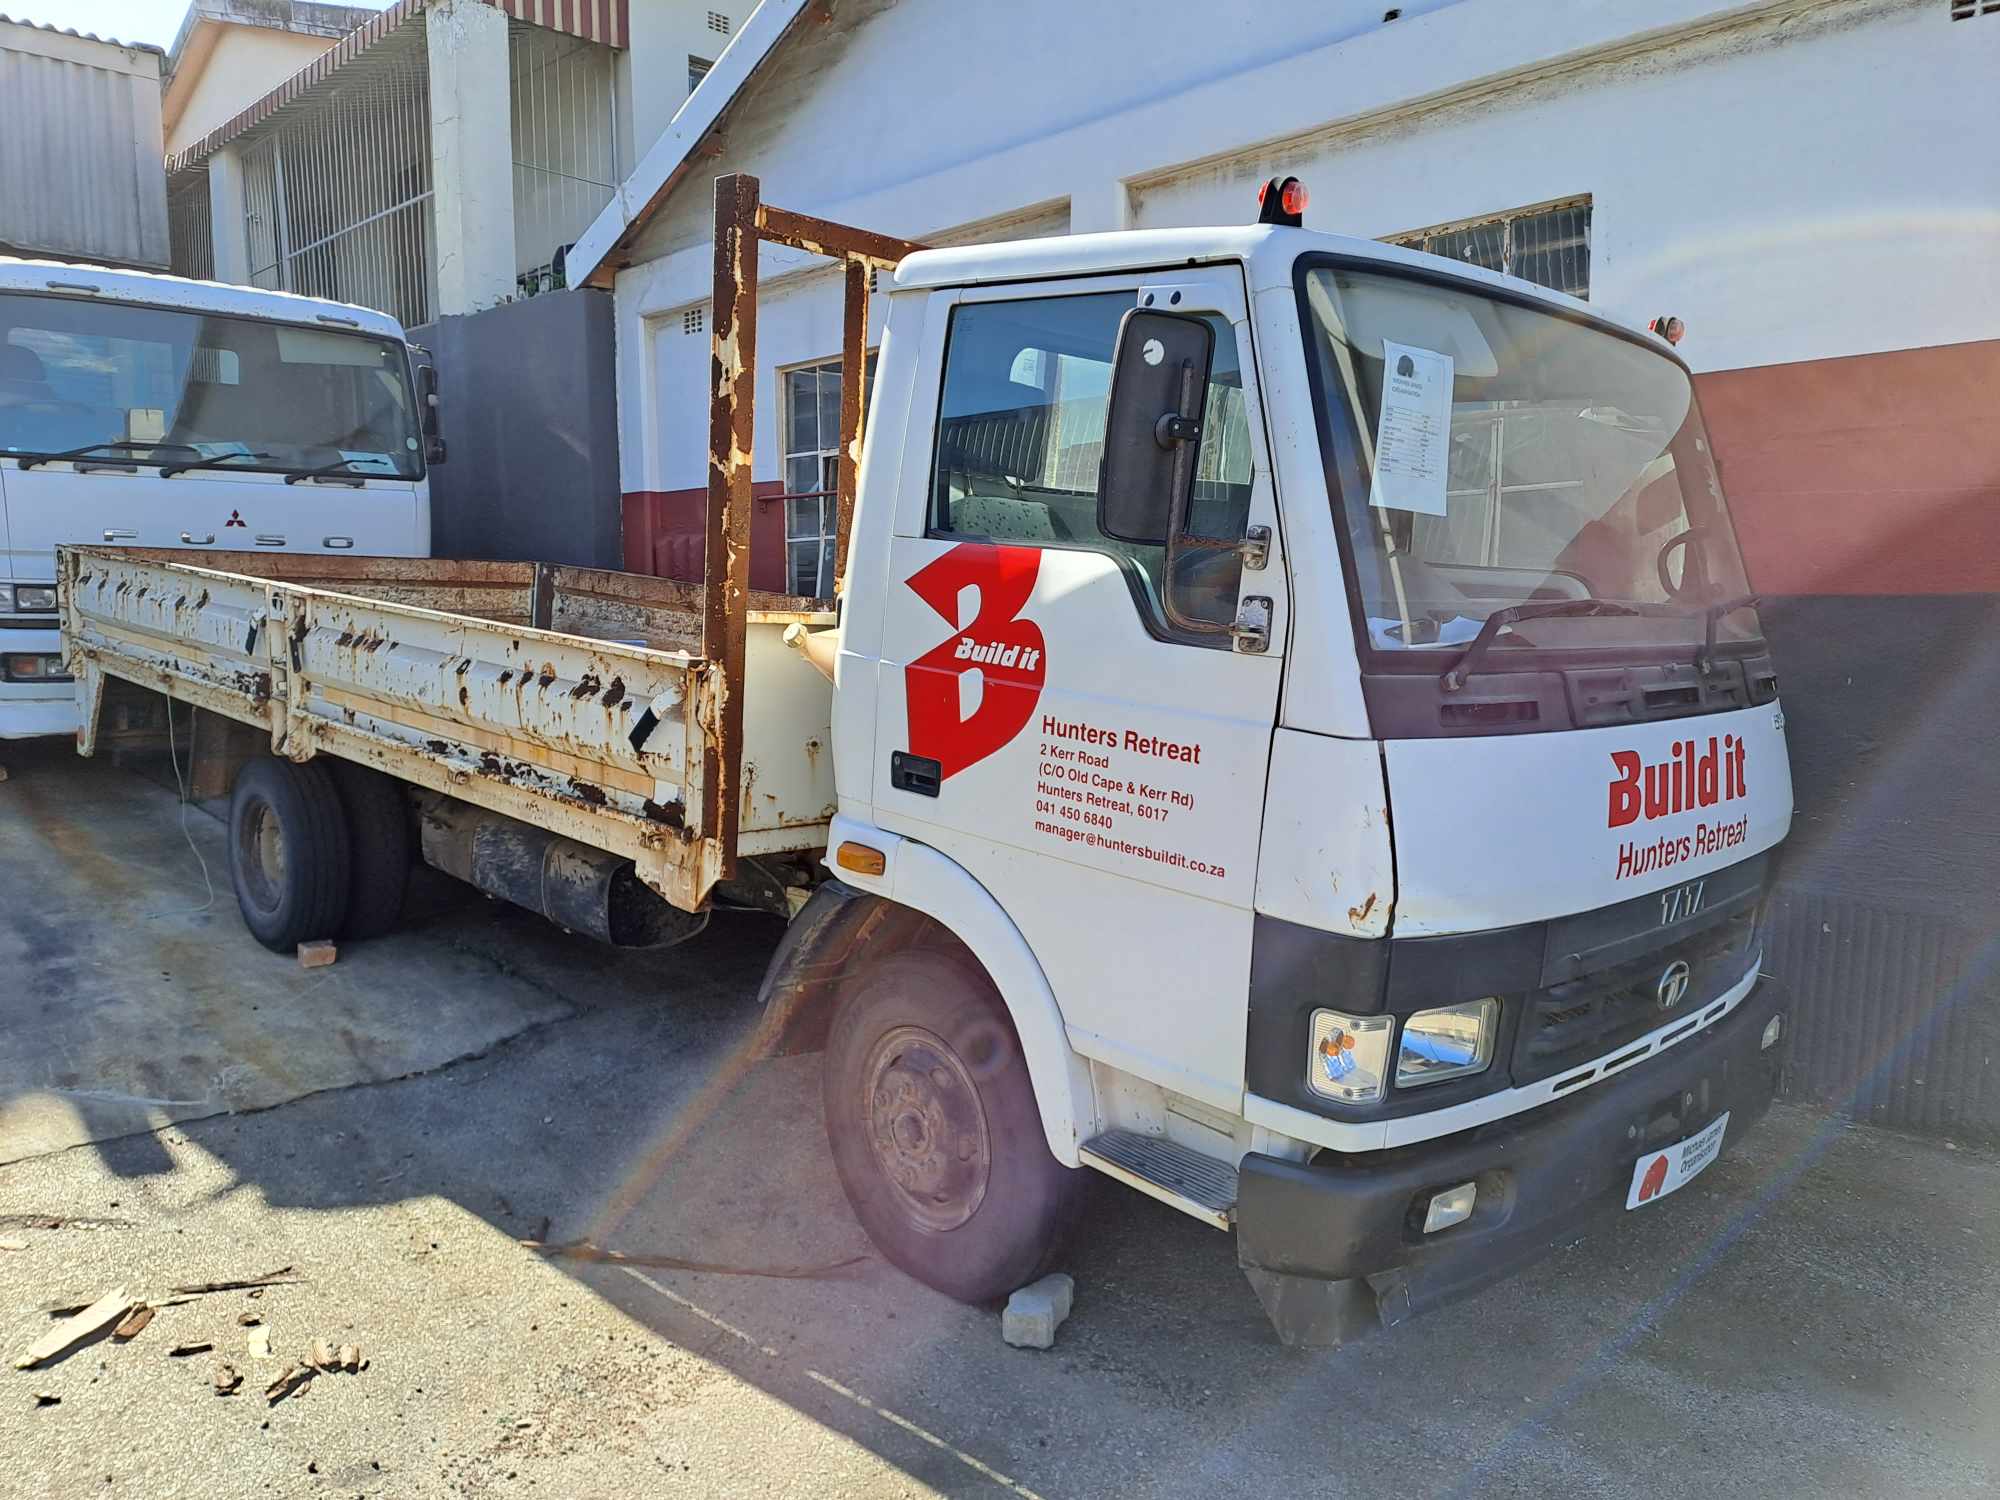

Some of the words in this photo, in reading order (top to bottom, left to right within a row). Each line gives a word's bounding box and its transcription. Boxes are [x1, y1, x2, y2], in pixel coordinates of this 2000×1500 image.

[103, 528, 354, 549] FUSO
[955, 637, 1018, 669] Build
[1018, 645, 1040, 671] it
[1040, 744, 1046, 755] 2
[1050, 745, 1075, 760] Kerr
[1078, 751, 1109, 768] Road
[1043, 715, 1117, 748] Hunters
[1124, 730, 1201, 764] Retreat
[1038, 783, 1082, 802] Hunters
[1087, 792, 1133, 816] Retreat,
[1138, 804, 1168, 821] 6017
[1039, 763, 1064, 778] (C/O
[1068, 769, 1088, 784] Old
[1092, 774, 1123, 792] Cape
[1127, 783, 1135, 794] &
[1140, 784, 1167, 801] Kerr
[1171, 791, 1193, 811] Rd)
[1608, 736, 1718, 828] Build
[1724, 734, 1746, 801] it
[1036, 800, 1055, 814] 041
[1060, 806, 1080, 821] 450
[1084, 812, 1112, 829] 6840
[1035, 821, 1225, 877] manager@huntersbuildit.co.za
[1616, 836, 1690, 880] Hunters
[1694, 814, 1747, 858] Retreat
